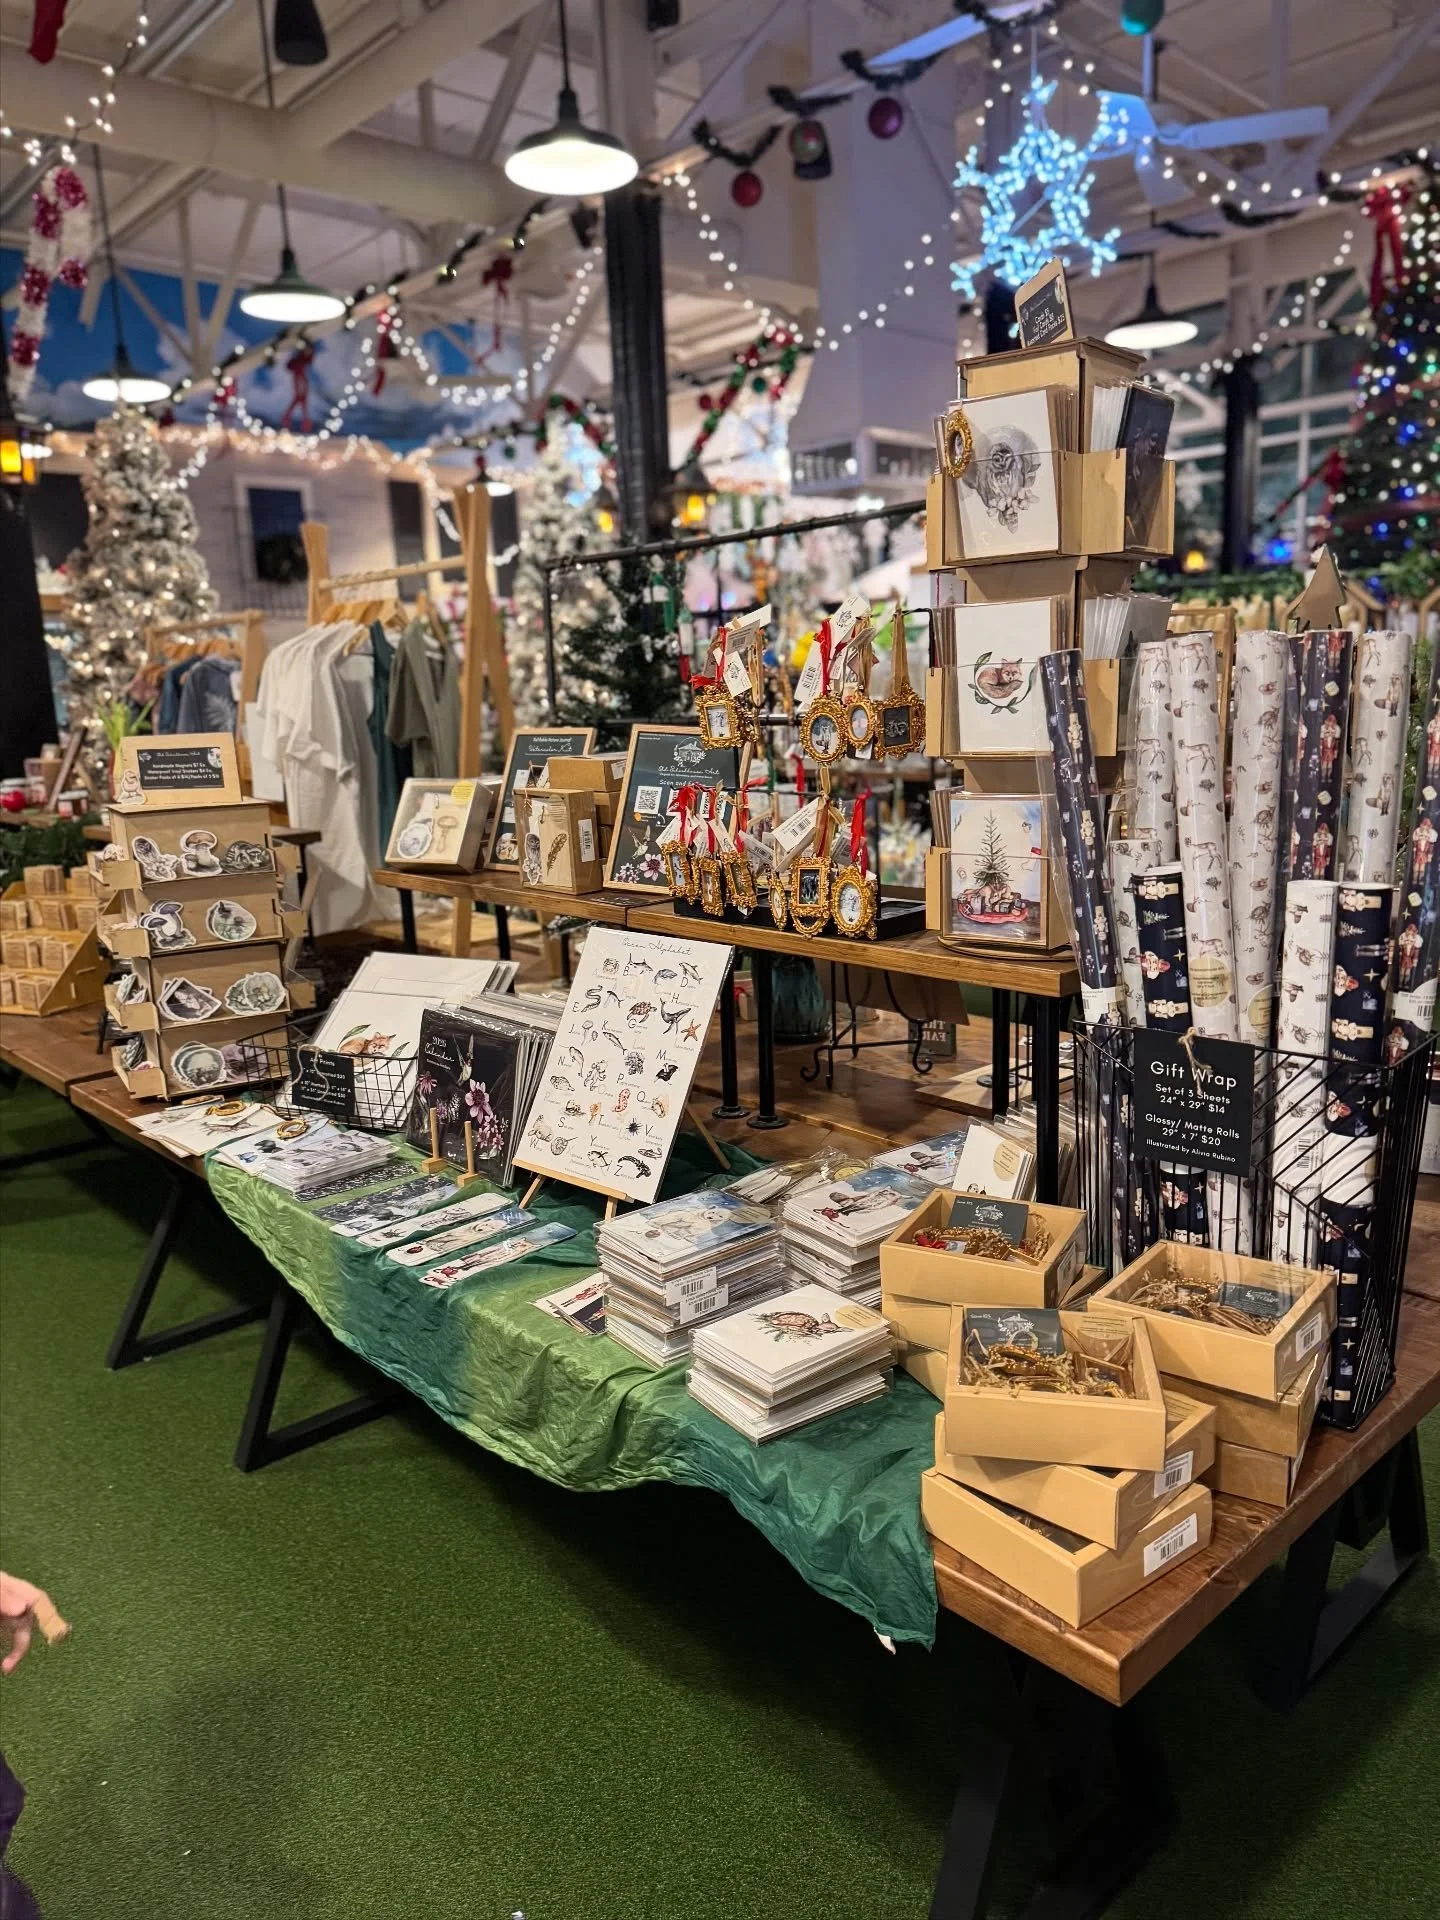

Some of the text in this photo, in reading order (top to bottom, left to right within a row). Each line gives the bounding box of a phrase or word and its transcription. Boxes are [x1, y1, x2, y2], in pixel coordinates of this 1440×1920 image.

[1150, 1061, 1237, 1091] Gift Wrap
[1156, 1083, 1230, 1104] Set of 3 Sheets
[1160, 1095, 1177, 1105] 24"
[1188, 1100, 1204, 1109] 29"
[1208, 1103, 1225, 1114] $14
[1145, 1114, 1240, 1139] Glossy/ Matte Rolls
[1162, 1128, 1178, 1136] 29"
[1201, 1135, 1221, 1146] $20
[1146, 1139, 1180, 1151] Illustrated
[1182, 1145, 1190, 1154] by
[1212, 1152, 1236, 1163] Rubino
